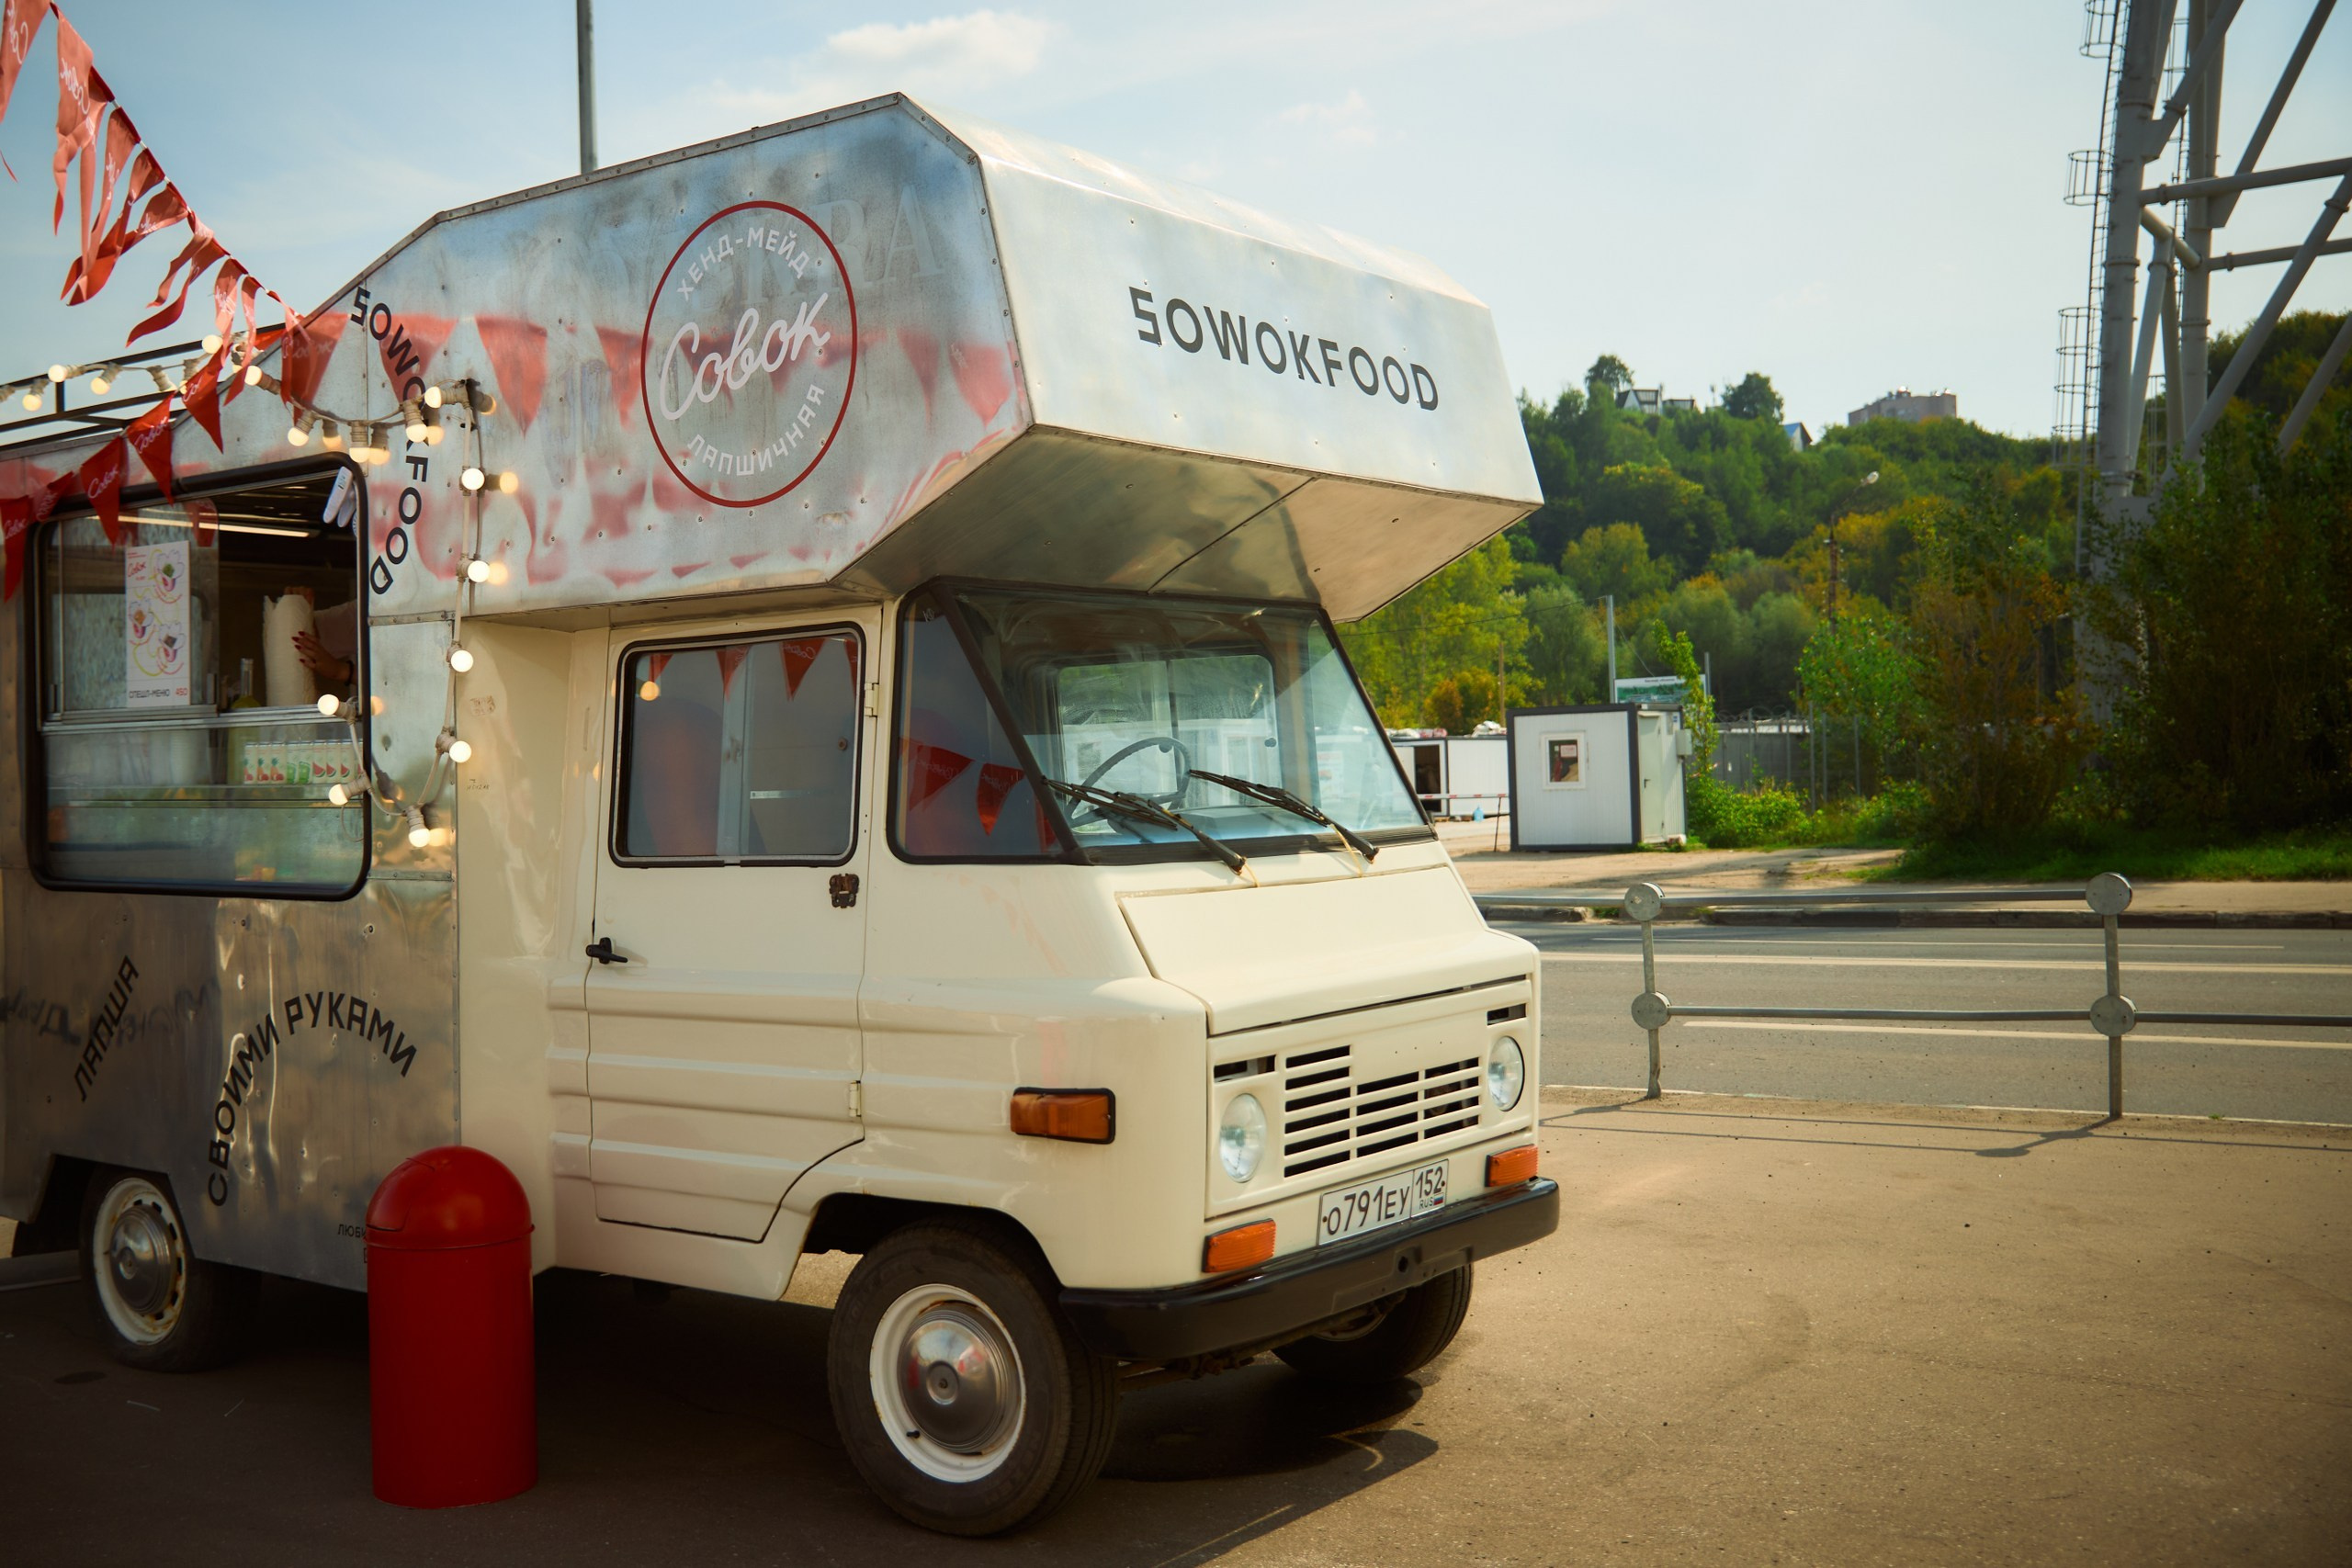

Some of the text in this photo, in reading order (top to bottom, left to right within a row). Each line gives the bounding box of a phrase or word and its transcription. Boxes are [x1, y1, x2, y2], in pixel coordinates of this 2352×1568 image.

[677, 227, 810, 300] ХЕНД-МЕЙД
[660, 292, 831, 421] Совок
[687, 384, 825, 476] ЛАПШИЧНАЯ
[74, 955, 139, 1102] ЛАПША
[208, 1012, 281, 1207] СВОИМИ
[284, 991, 418, 1077] РУКАМИ
[1416, 1166, 1443, 1198] 152
[1419, 1196, 1433, 1210] RUS
